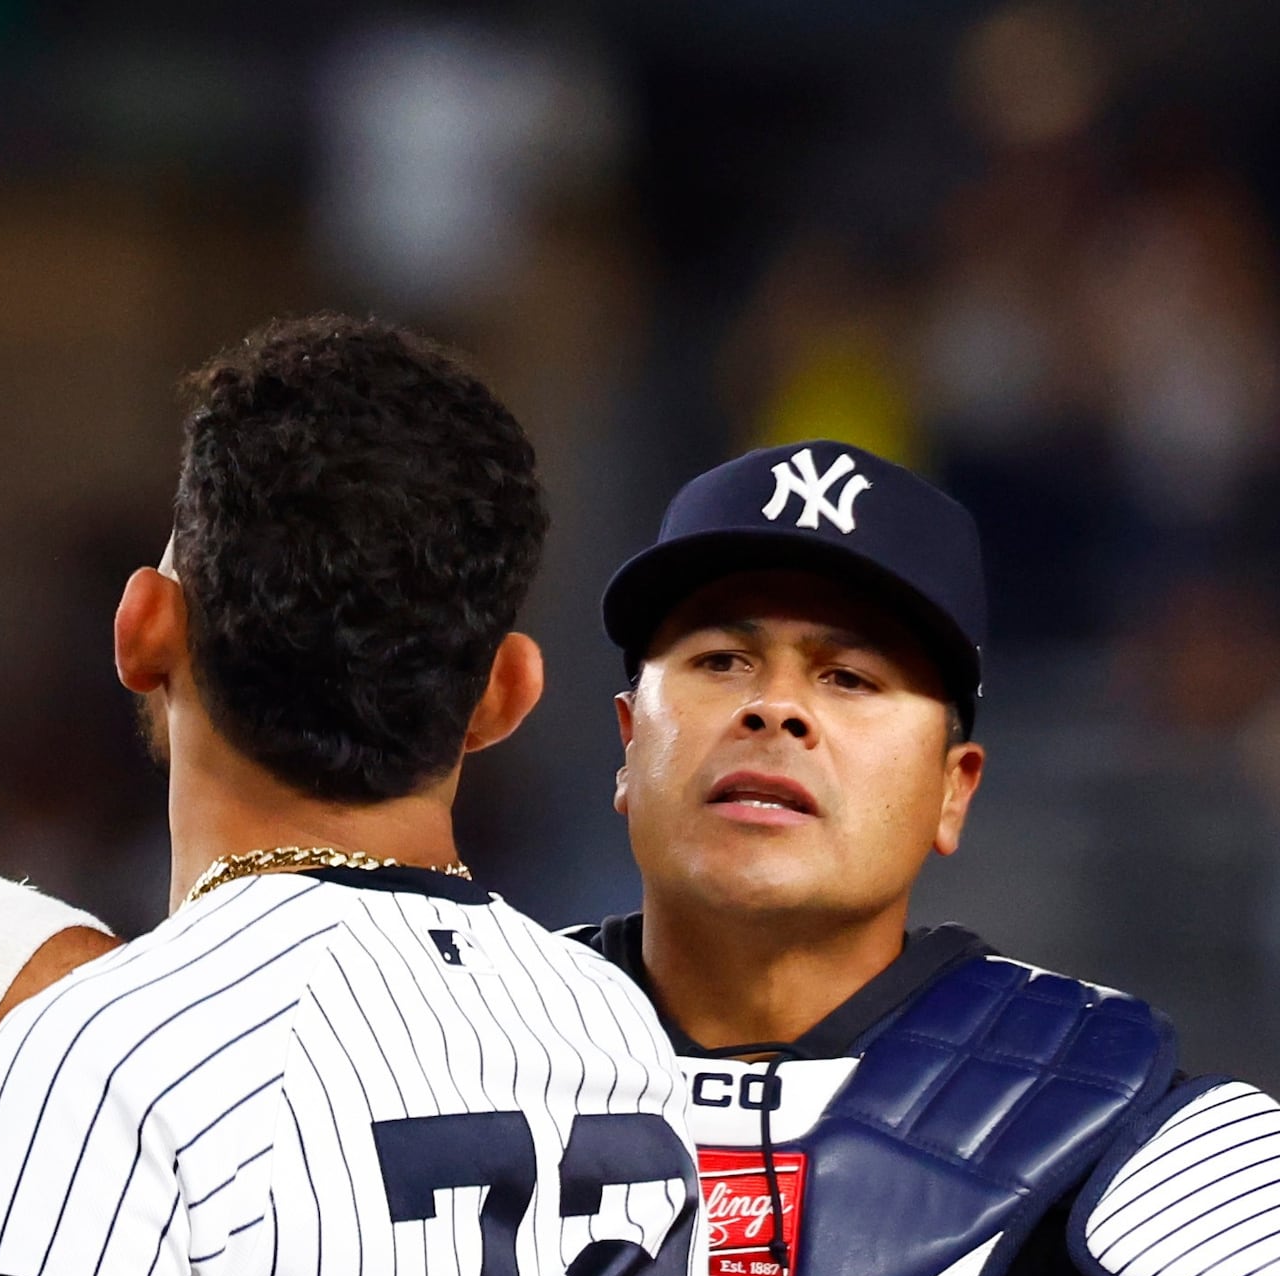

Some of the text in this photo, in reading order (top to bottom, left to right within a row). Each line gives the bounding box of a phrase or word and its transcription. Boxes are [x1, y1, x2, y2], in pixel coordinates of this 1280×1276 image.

[761, 448, 873, 535] NY
[682, 1071, 782, 1110] CO
[706, 1182, 793, 1239] lings
[719, 1259, 781, 1276] Est. 1887
